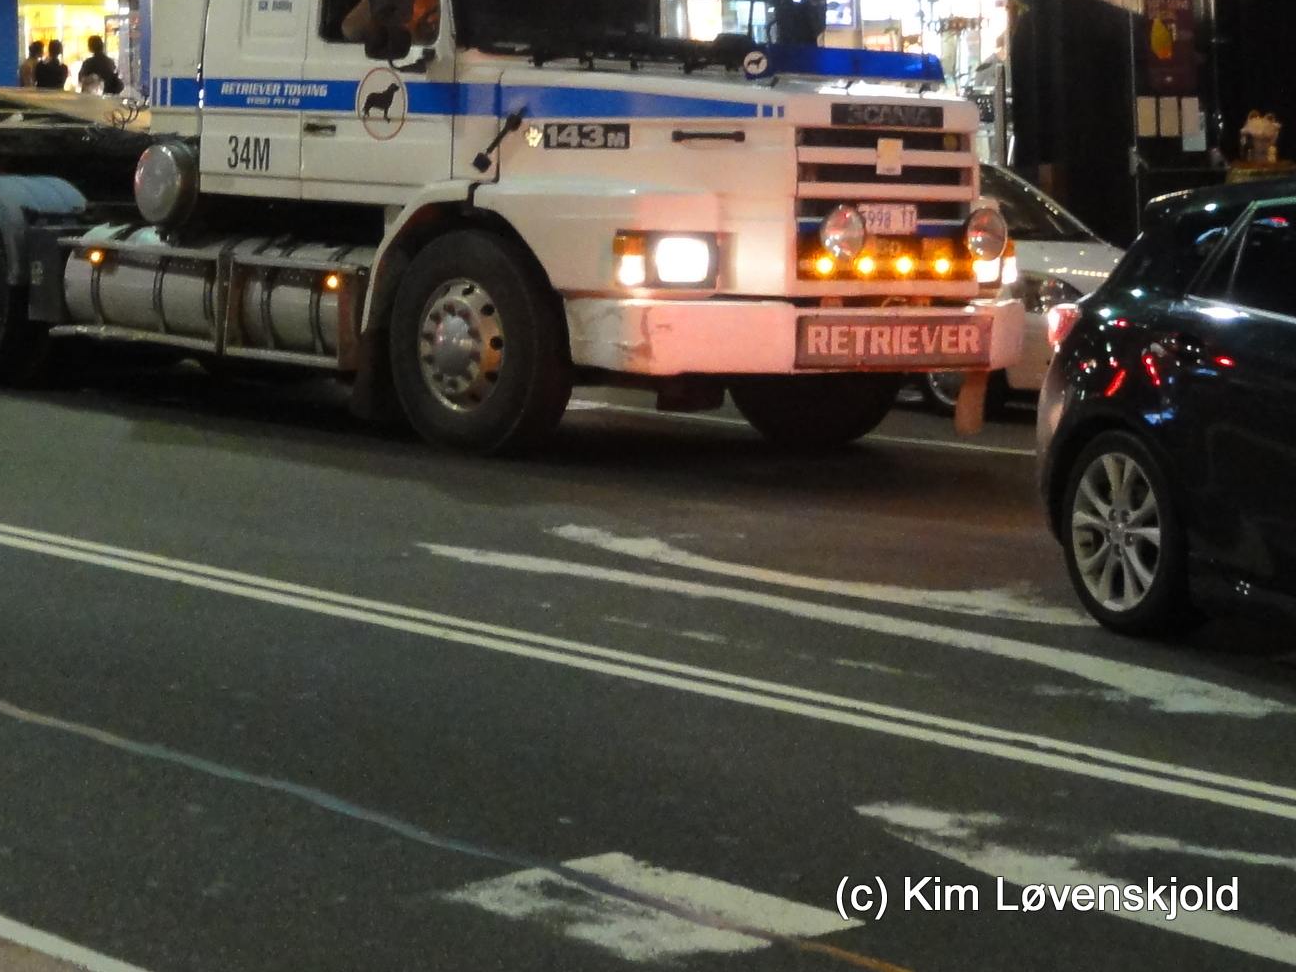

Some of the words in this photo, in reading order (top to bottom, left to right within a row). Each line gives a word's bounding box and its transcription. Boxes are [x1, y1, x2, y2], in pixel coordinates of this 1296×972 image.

[221, 82, 281, 96] RETRIEVER
[284, 83, 328, 97] TOWING
[227, 135, 271, 172] 34M
[807, 325, 980, 356] RETRIEVER
